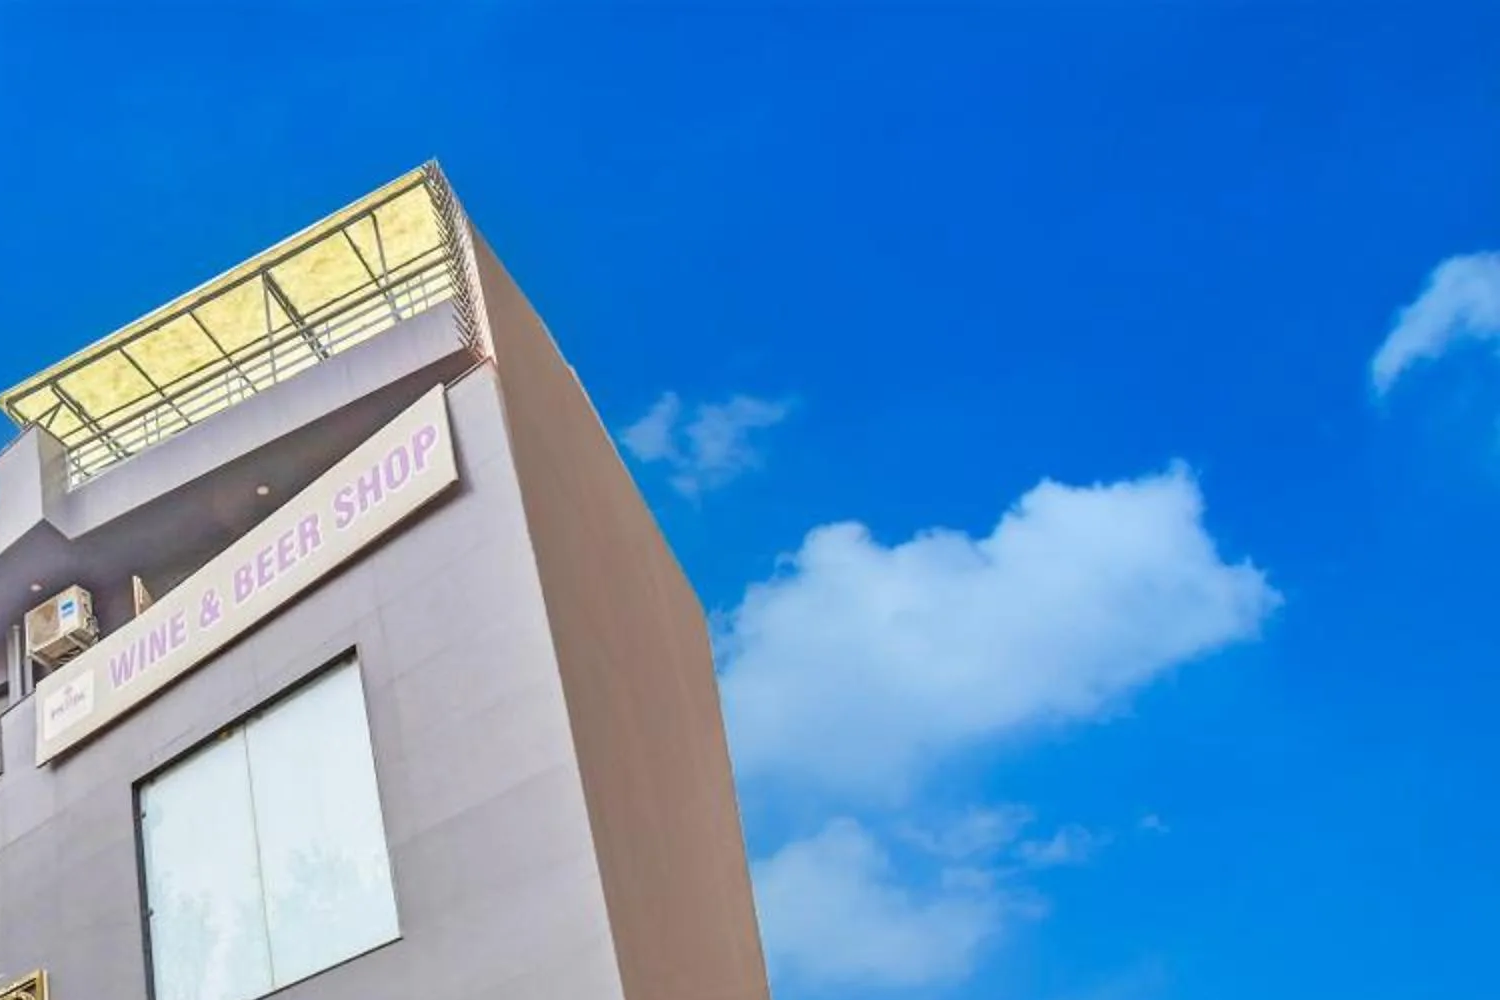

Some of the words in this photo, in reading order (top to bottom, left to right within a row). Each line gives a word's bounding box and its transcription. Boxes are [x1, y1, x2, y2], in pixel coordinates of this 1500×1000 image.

[109, 607, 187, 689] WINE
[198, 587, 223, 626] &
[232, 512, 323, 604] BEER
[334, 424, 438, 531] SHOP
